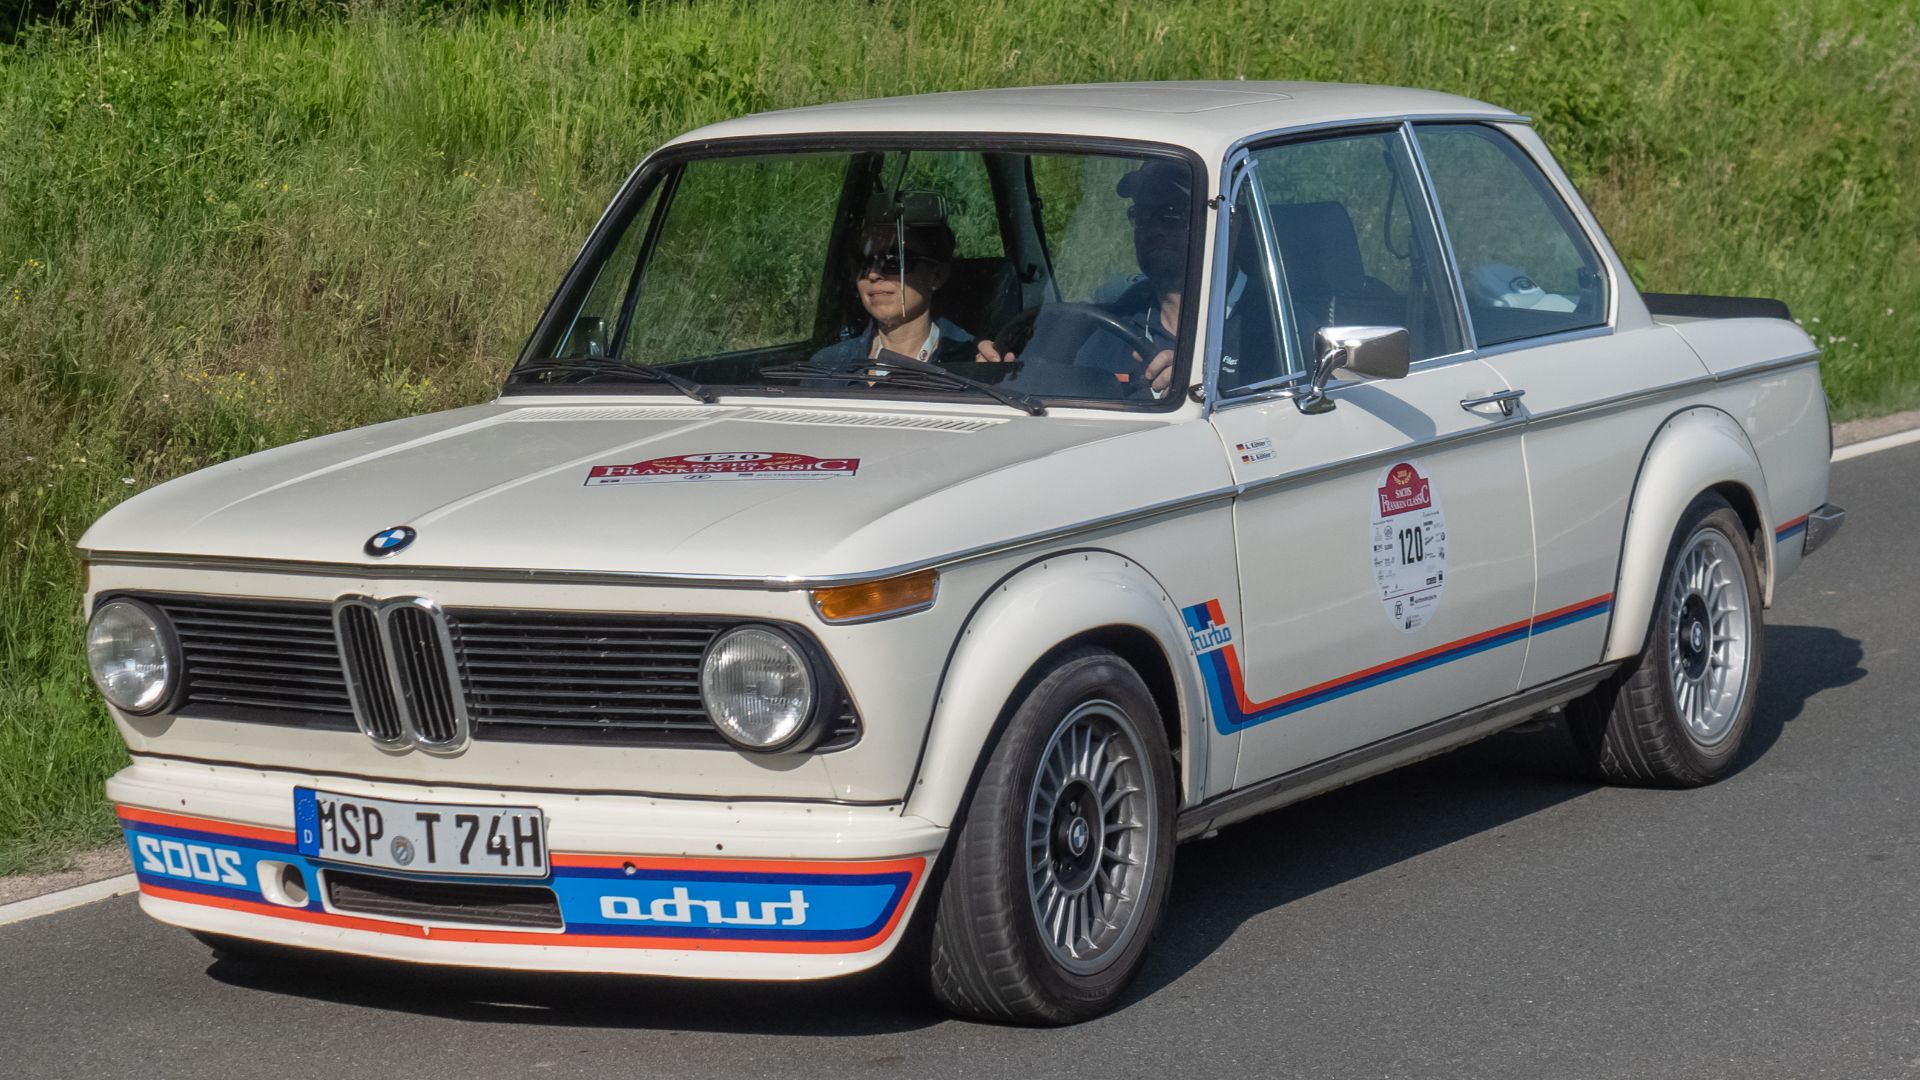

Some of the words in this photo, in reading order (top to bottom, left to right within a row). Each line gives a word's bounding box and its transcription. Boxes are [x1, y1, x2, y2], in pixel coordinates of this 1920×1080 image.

[601, 466, 721, 476] FRANKEN
[731, 460, 848, 471] CLASSIC
[1381, 494, 1406, 512] FRANKEN
[1407, 485, 1429, 506] CLASSIC
[1399, 526, 1423, 565] 120
[1189, 622, 1232, 651] turbo
[303, 828, 313, 844] D
[317, 800, 384, 857] MSP
[415, 812, 441, 864] T
[454, 814, 542, 867] 74H
